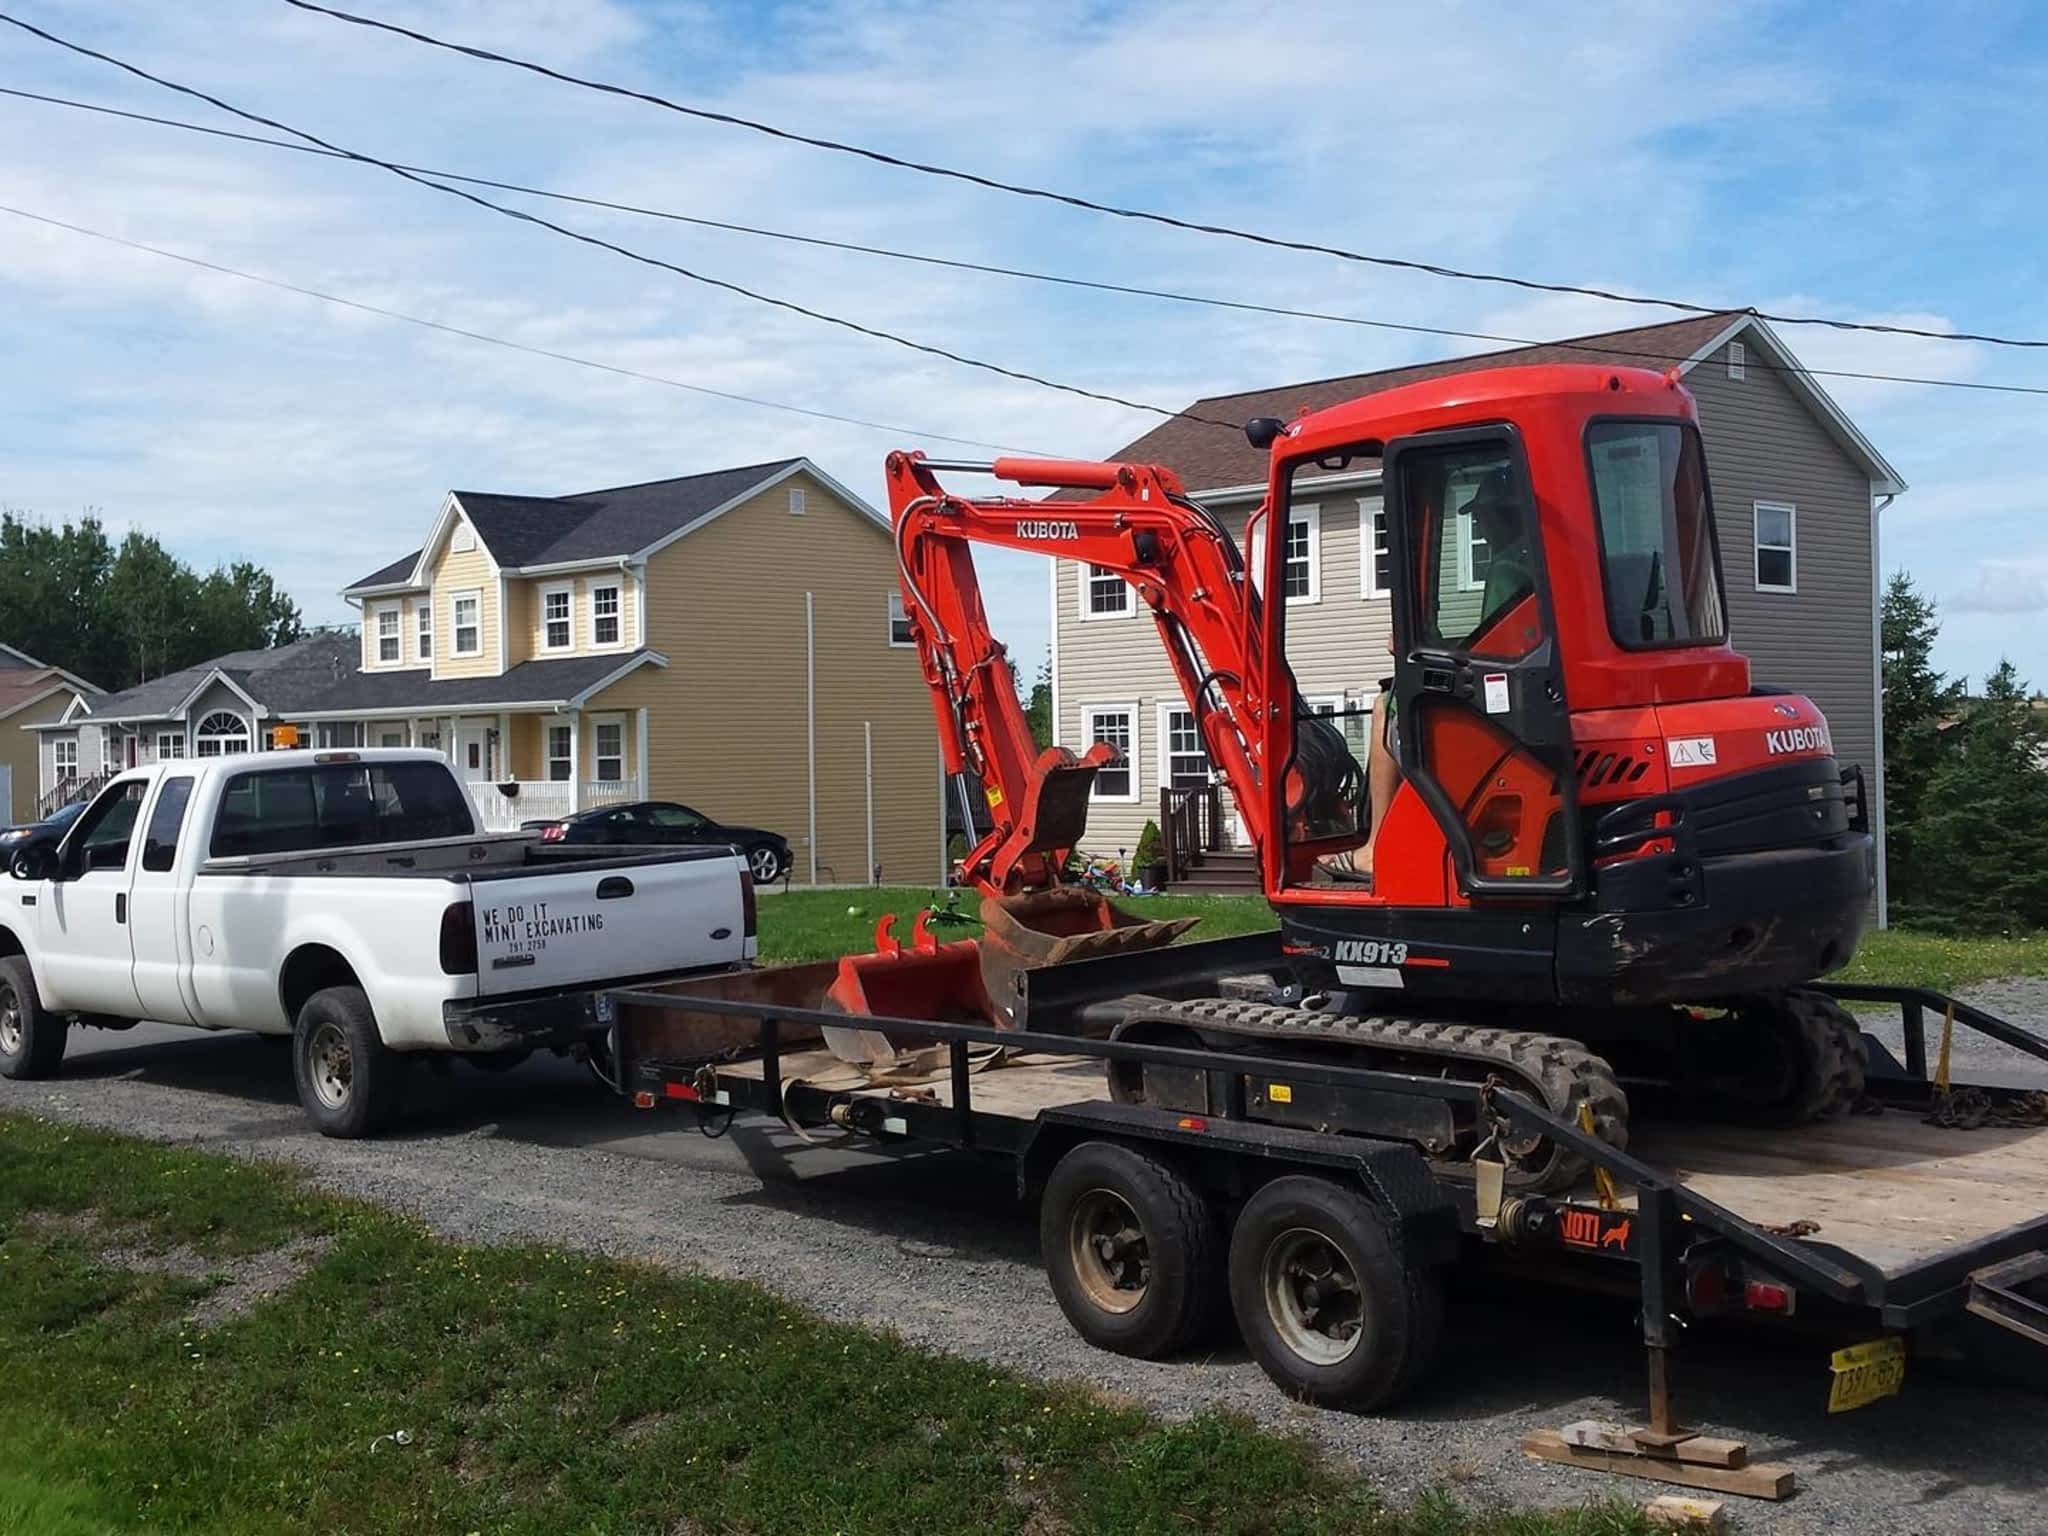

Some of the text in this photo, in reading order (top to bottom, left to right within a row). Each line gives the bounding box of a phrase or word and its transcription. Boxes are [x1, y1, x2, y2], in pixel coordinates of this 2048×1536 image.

[1016, 521, 1079, 540] KUBOTA
[1765, 727, 1831, 755] KUBOTA
[482, 902, 547, 926] WE DO IT
[484, 913, 604, 943] MINI EXCAVATING
[1335, 940, 1409, 964] KX91-3
